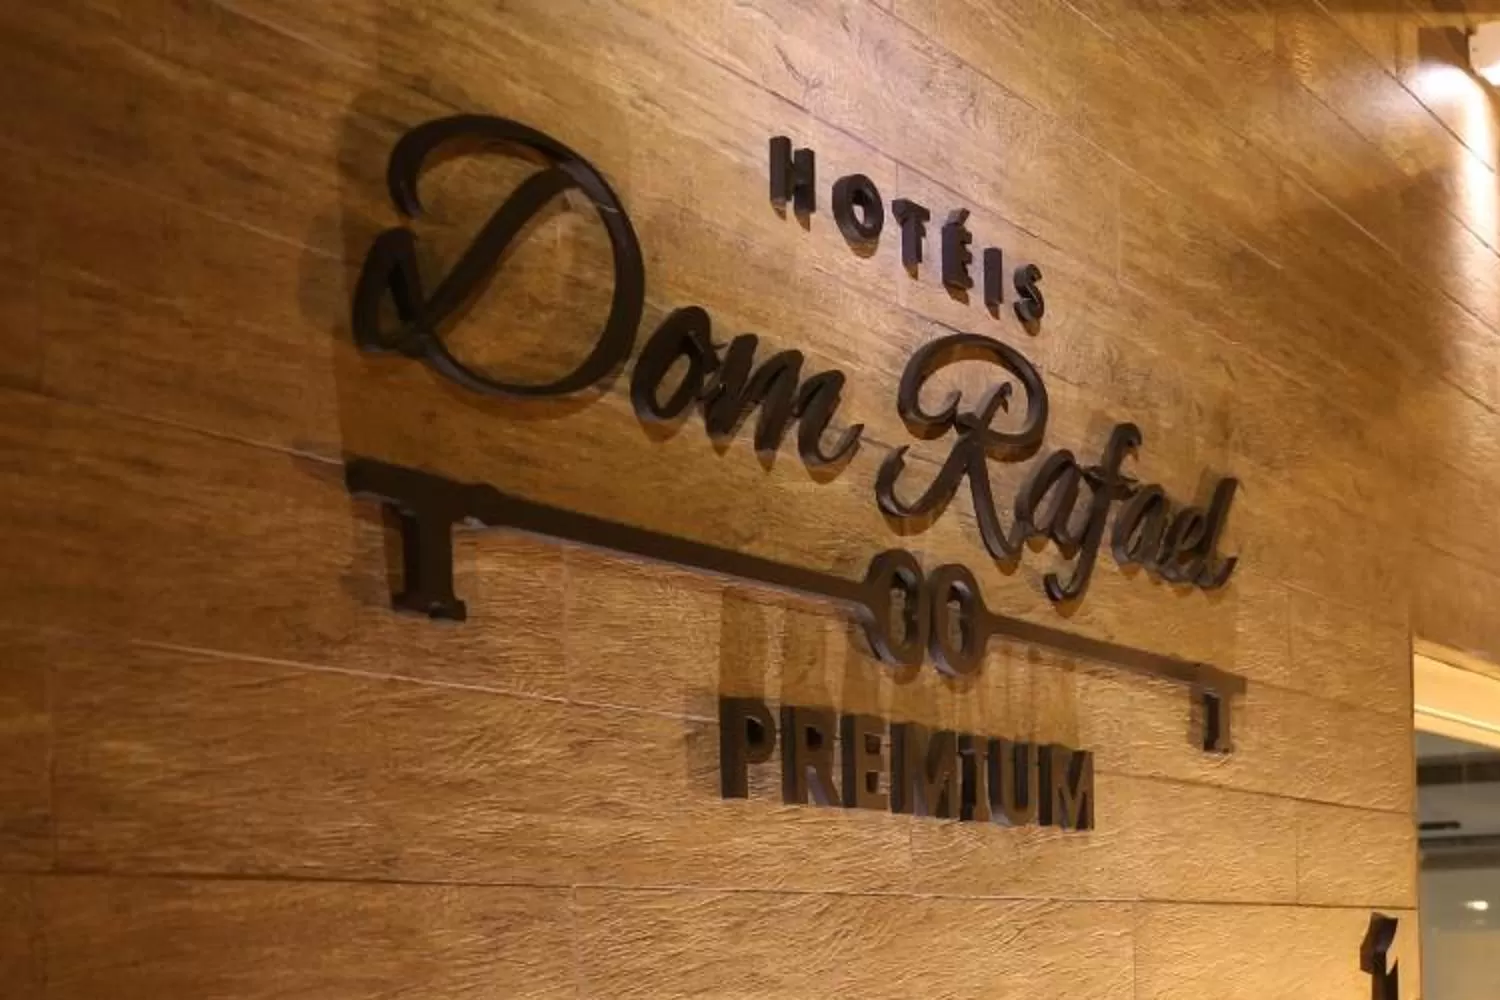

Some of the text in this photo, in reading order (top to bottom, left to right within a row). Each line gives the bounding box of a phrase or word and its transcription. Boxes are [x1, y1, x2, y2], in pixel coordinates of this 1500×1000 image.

[769, 135, 1045, 324] HOTÉIS
[352, 113, 1238, 601] Dom Rafael
[719, 696, 1095, 829] PREMIUM
